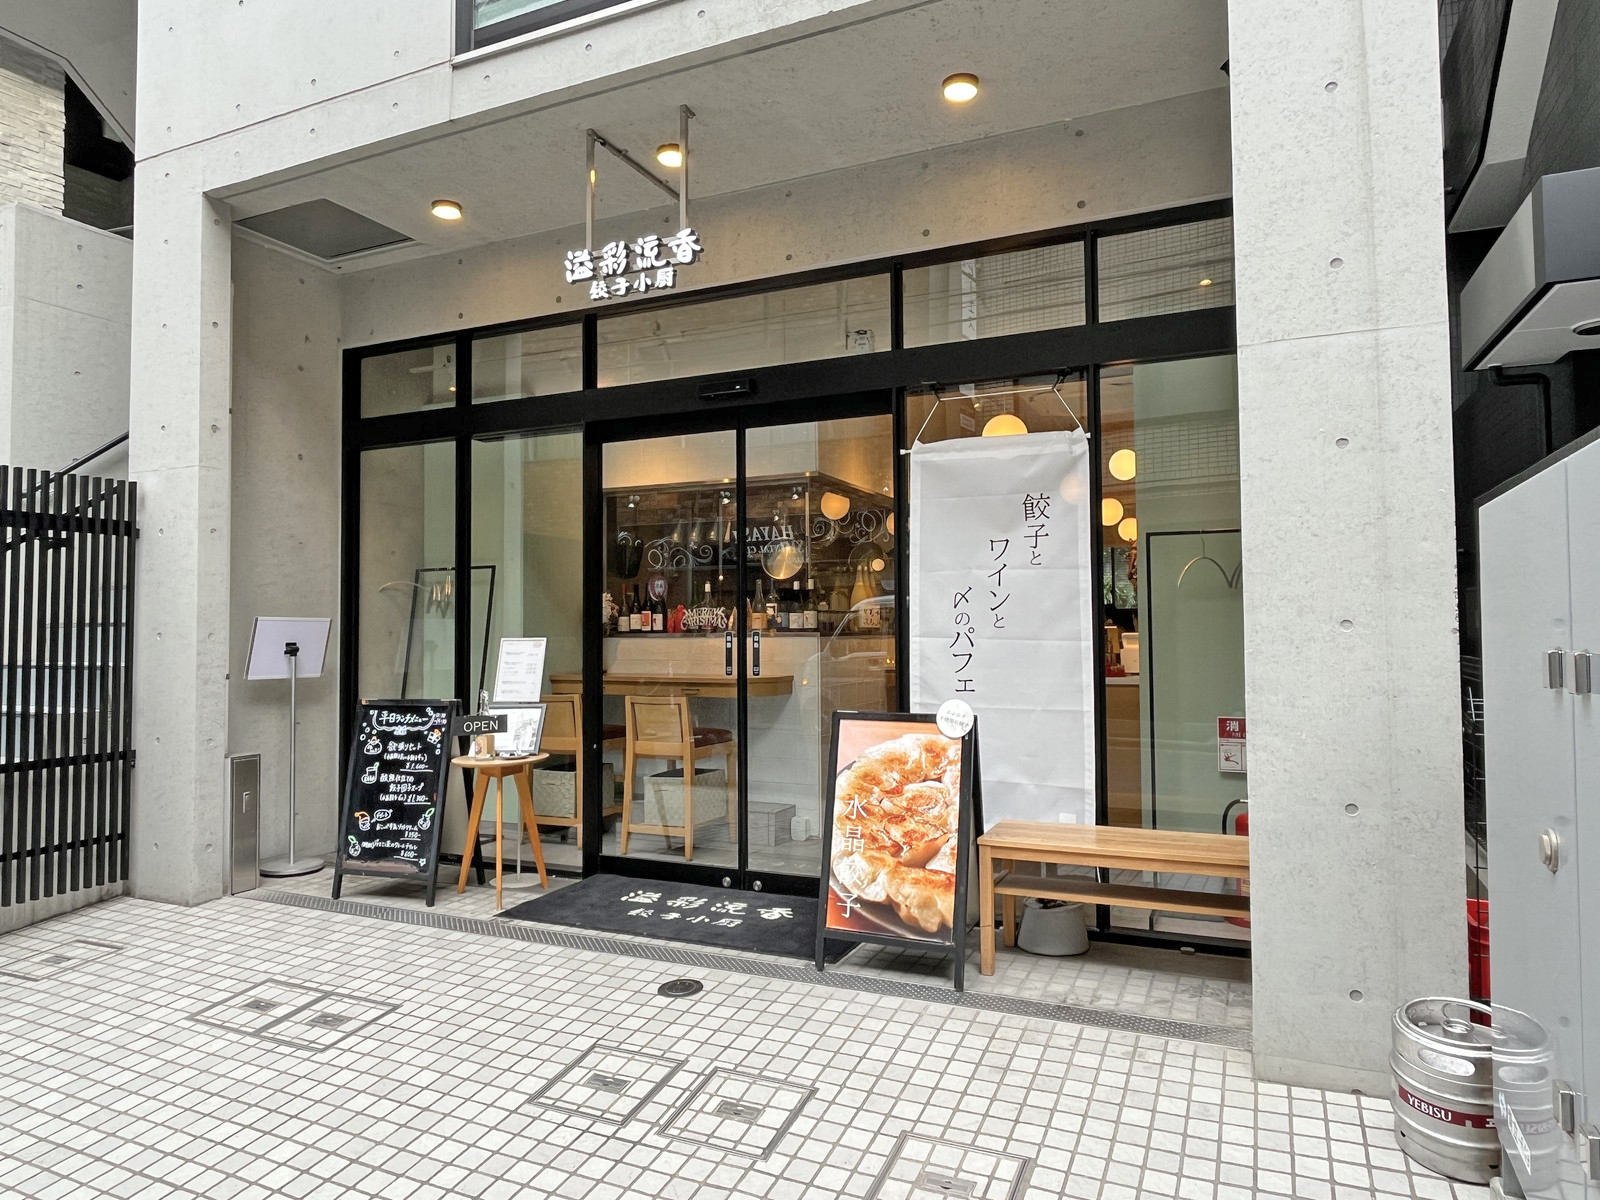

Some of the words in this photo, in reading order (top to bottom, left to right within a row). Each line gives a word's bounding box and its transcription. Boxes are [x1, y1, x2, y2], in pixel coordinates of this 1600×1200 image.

[564, 227, 701, 283] 溢彩流香
[1022, 492, 1051, 566] 餃子と
[987, 538, 1011, 629] ワインと
[949, 586, 976, 693] 〆のパフェ
[379, 710, 429, 725] 平日ランチメニュー
[463, 720, 499, 732] OPEN
[836, 794, 870, 919] 水晶餃子
[1407, 1093, 1452, 1122] YEBISU
